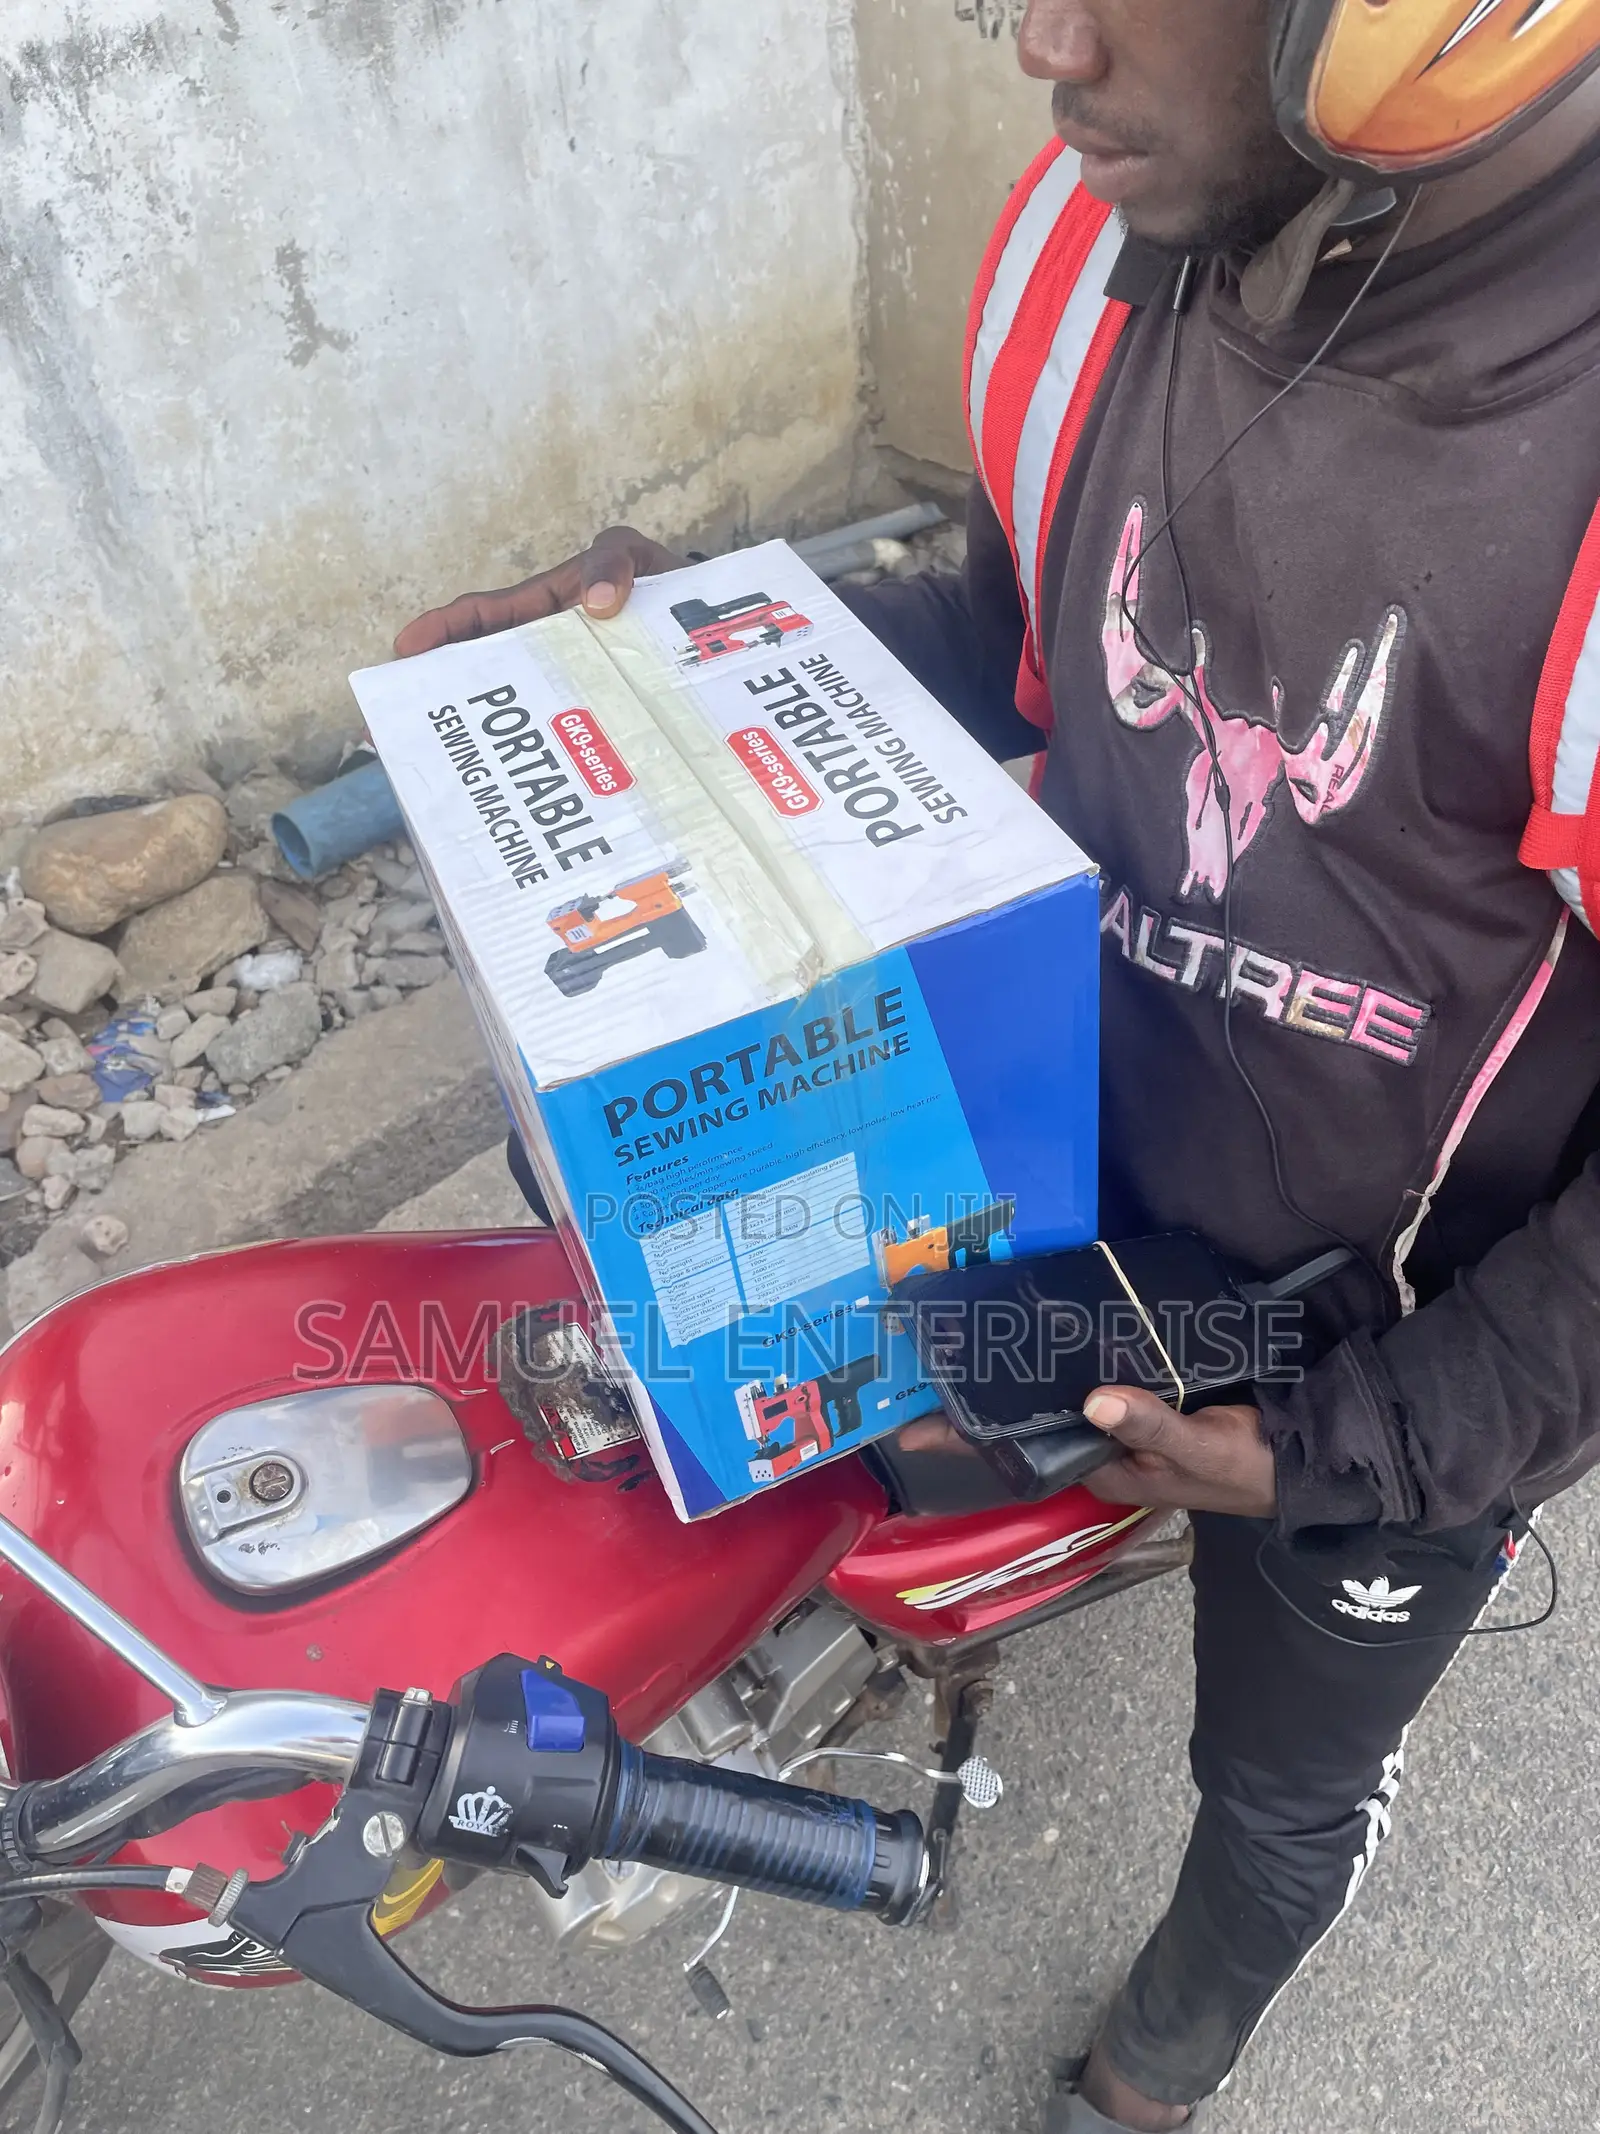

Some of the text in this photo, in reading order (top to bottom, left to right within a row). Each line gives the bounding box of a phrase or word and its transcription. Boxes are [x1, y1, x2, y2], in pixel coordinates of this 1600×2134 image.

[560, 714, 617, 792] GK9-series
[743, 667, 925, 848] PORTABLE
[798, 653, 969, 824] SEWING MACHINE
[466, 684, 614, 872] PORTABLE
[742, 731, 810, 810] GK9-series
[427, 704, 550, 890] SEWING MACHINE
[603, 986, 907, 1139] PORTABLE
[614, 1031, 912, 1167] SEWING MACHINE
[729, 1172, 748, 1183] wire
[785, 1149, 805, 1161] high
[849, 1125, 863, 1135] low
[890, 1108, 905, 1118] low
[906, 1100, 925, 1112] heat
[926, 1094, 942, 1104] rise
[626, 1155, 689, 1185] Features
[666, 1168, 714, 1193] needles/min
[715, 1155, 746, 1171] sewing
[747, 1142, 775, 1159] speed
[666, 1169, 687, 1183] high
[687, 1181, 703, 1193] per
[704, 1173, 721, 1184] day
[796, 1166, 827, 1180] insulating
[829, 1157, 849, 1167] plastic
[639, 1187, 739, 1233] Technical data
[670, 1258, 693, 1270] weight
[673, 1239, 695, 1250] power
[691, 1255, 724, 1270] revolution
[696, 1288, 716, 1298] speed
[762, 1303, 855, 1348] GK9-series
[1330, 1599, 1411, 1623] adidas
